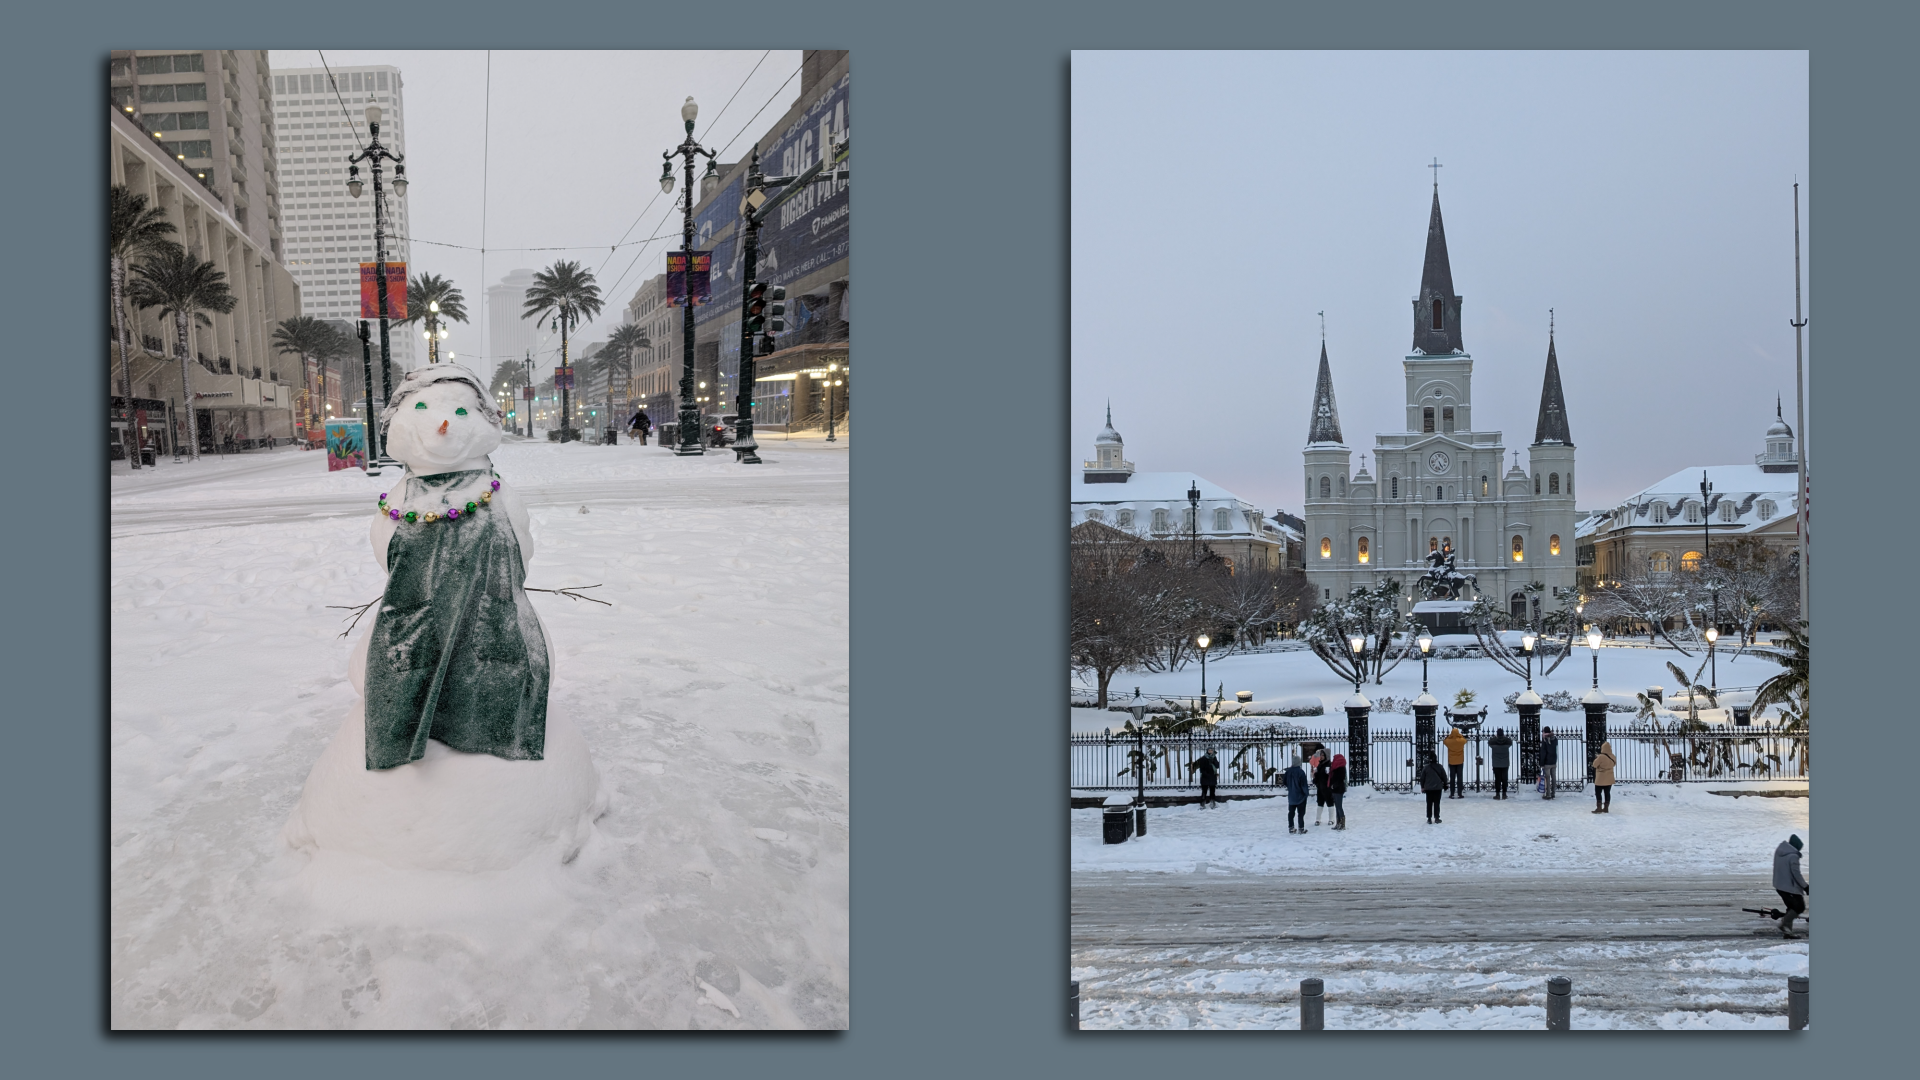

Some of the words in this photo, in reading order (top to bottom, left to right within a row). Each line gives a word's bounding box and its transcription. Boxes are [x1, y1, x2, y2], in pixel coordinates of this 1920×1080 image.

[783, 129, 813, 192] BIG
[781, 182, 814, 230] BIGGER
[821, 203, 849, 228] FANDUEL
[667, 256, 686, 264] NADA
[692, 256, 710, 264] NADA
[361, 267, 377, 275] NAD
[386, 267, 405, 275] NADA
